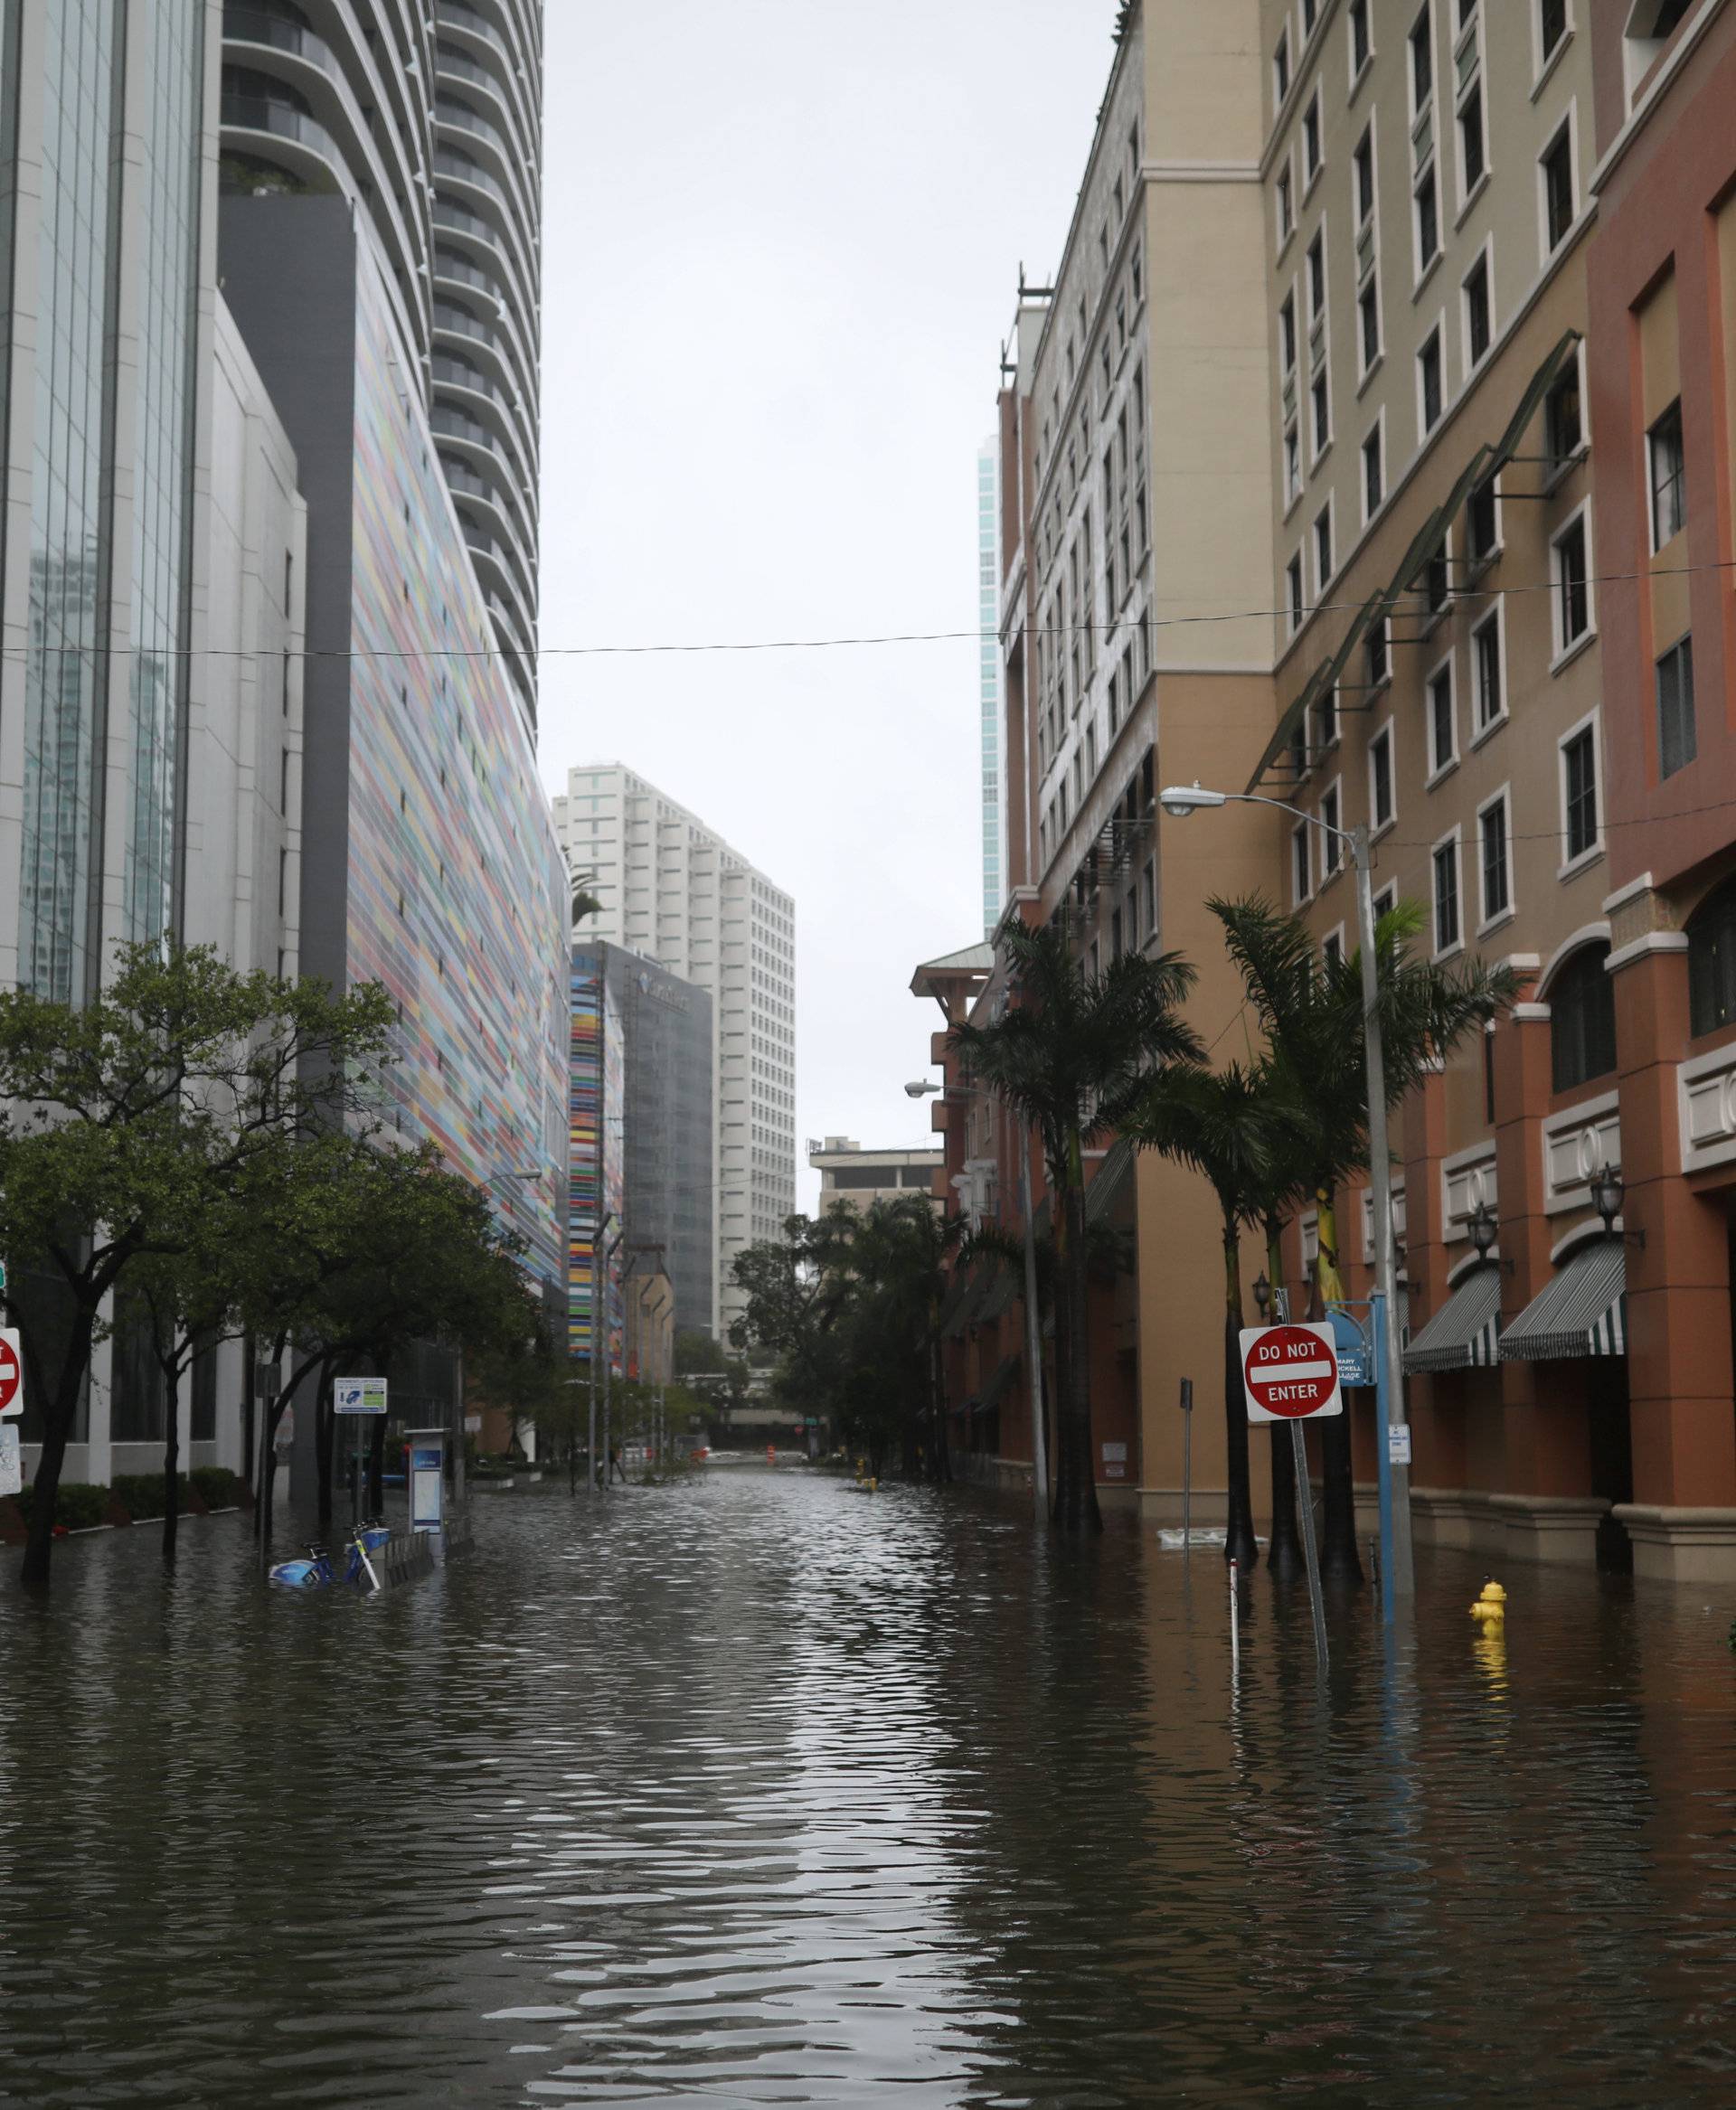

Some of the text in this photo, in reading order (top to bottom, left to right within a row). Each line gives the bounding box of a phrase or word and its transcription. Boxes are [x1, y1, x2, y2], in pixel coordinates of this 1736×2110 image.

[1259, 1342, 1316, 1361] DO NOT
[1268, 1384, 1318, 1401] ENTER
